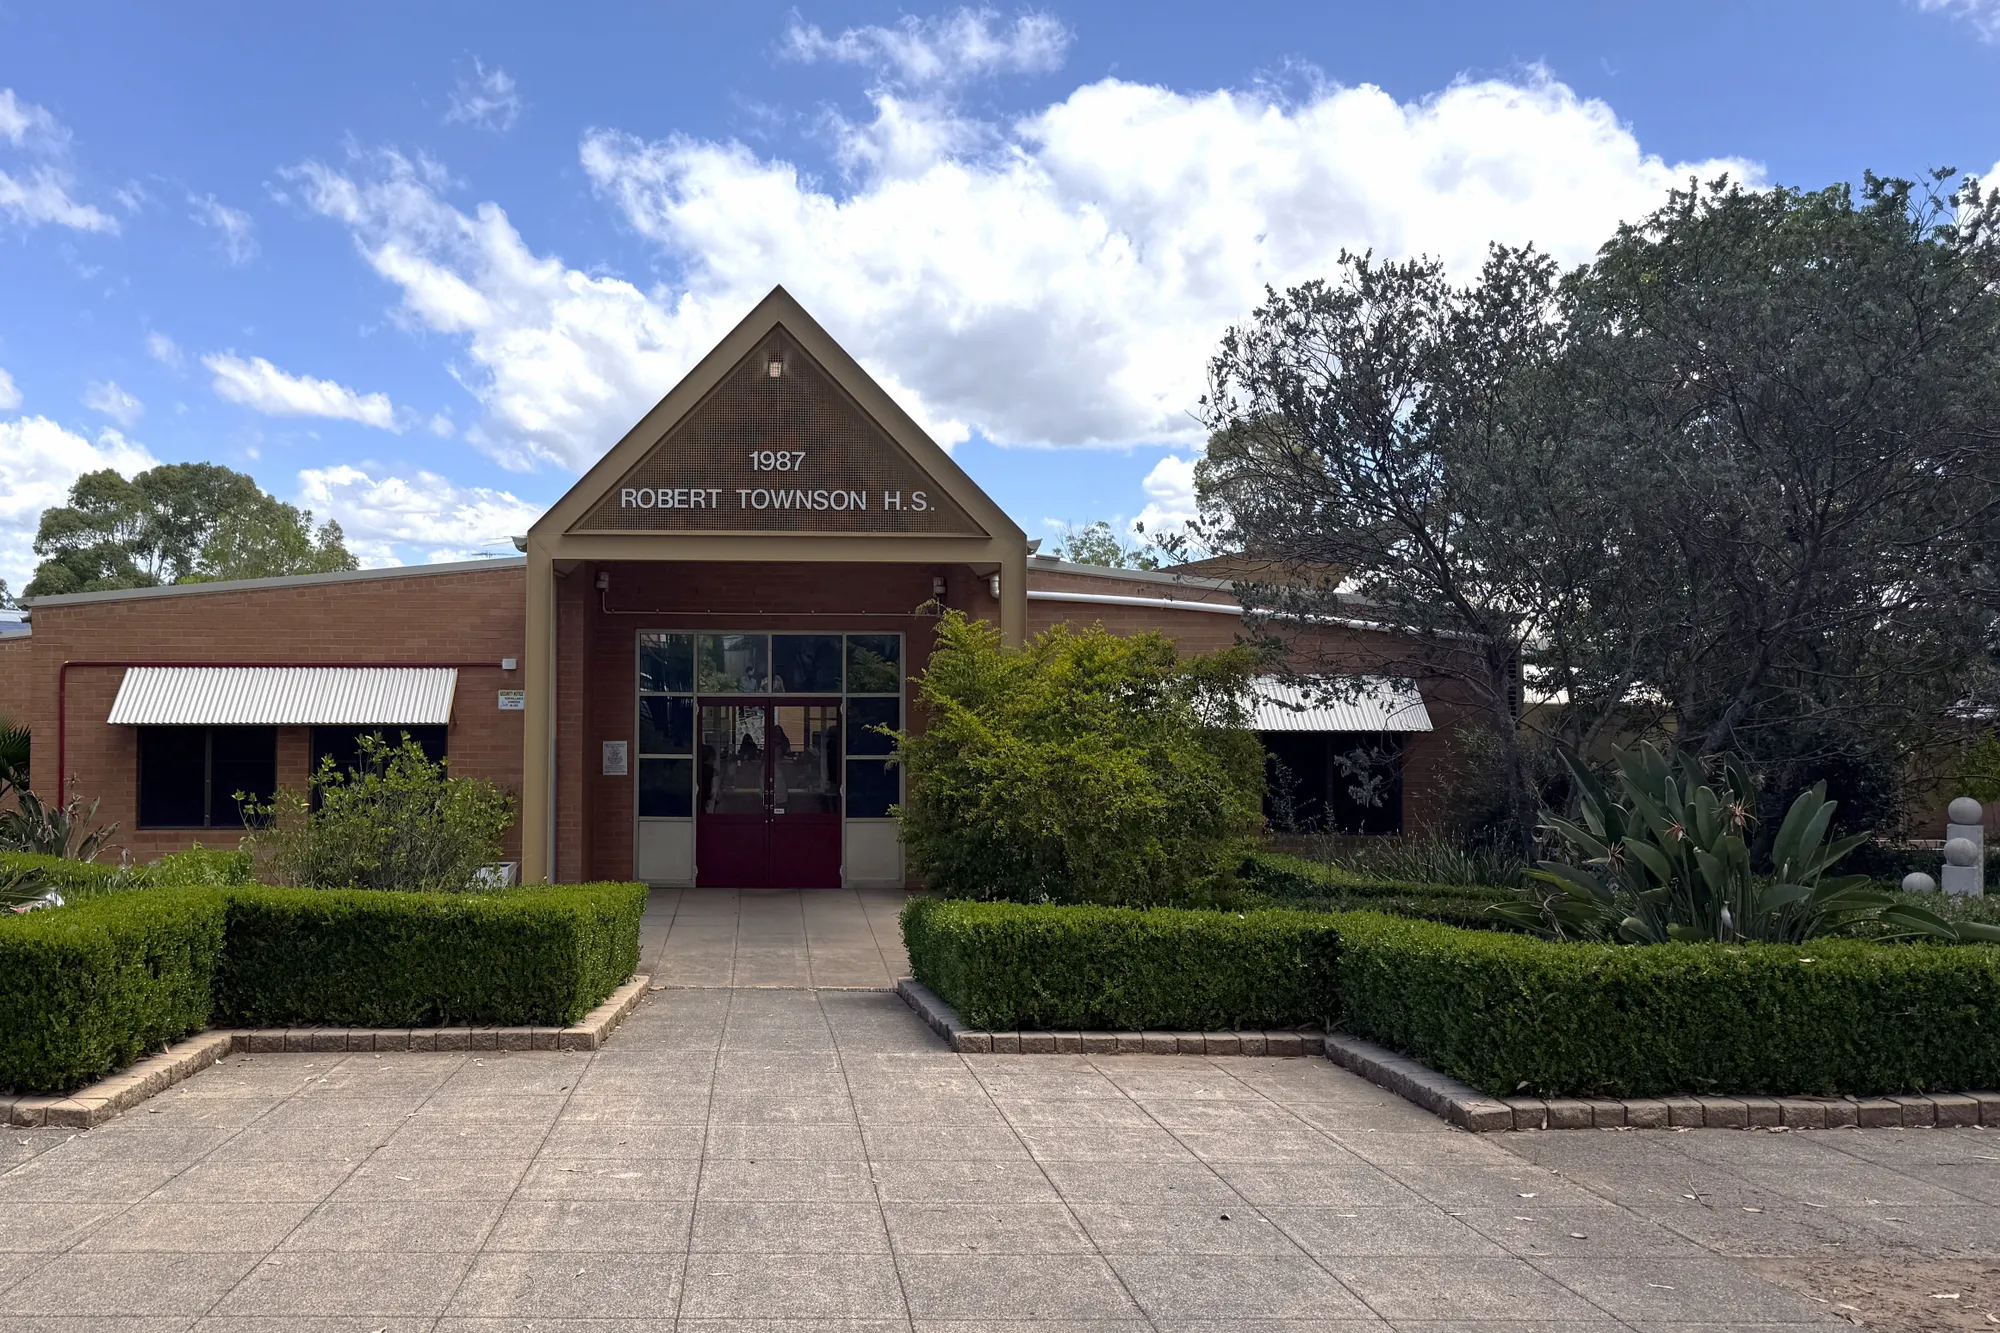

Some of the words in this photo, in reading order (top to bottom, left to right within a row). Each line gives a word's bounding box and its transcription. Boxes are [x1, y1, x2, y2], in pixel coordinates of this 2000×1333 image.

[749, 451, 806, 471] 1987
[621, 489, 722, 509] ROBERT
[736, 490, 867, 510] TOWNSON
[883, 491, 936, 511] H.S.
